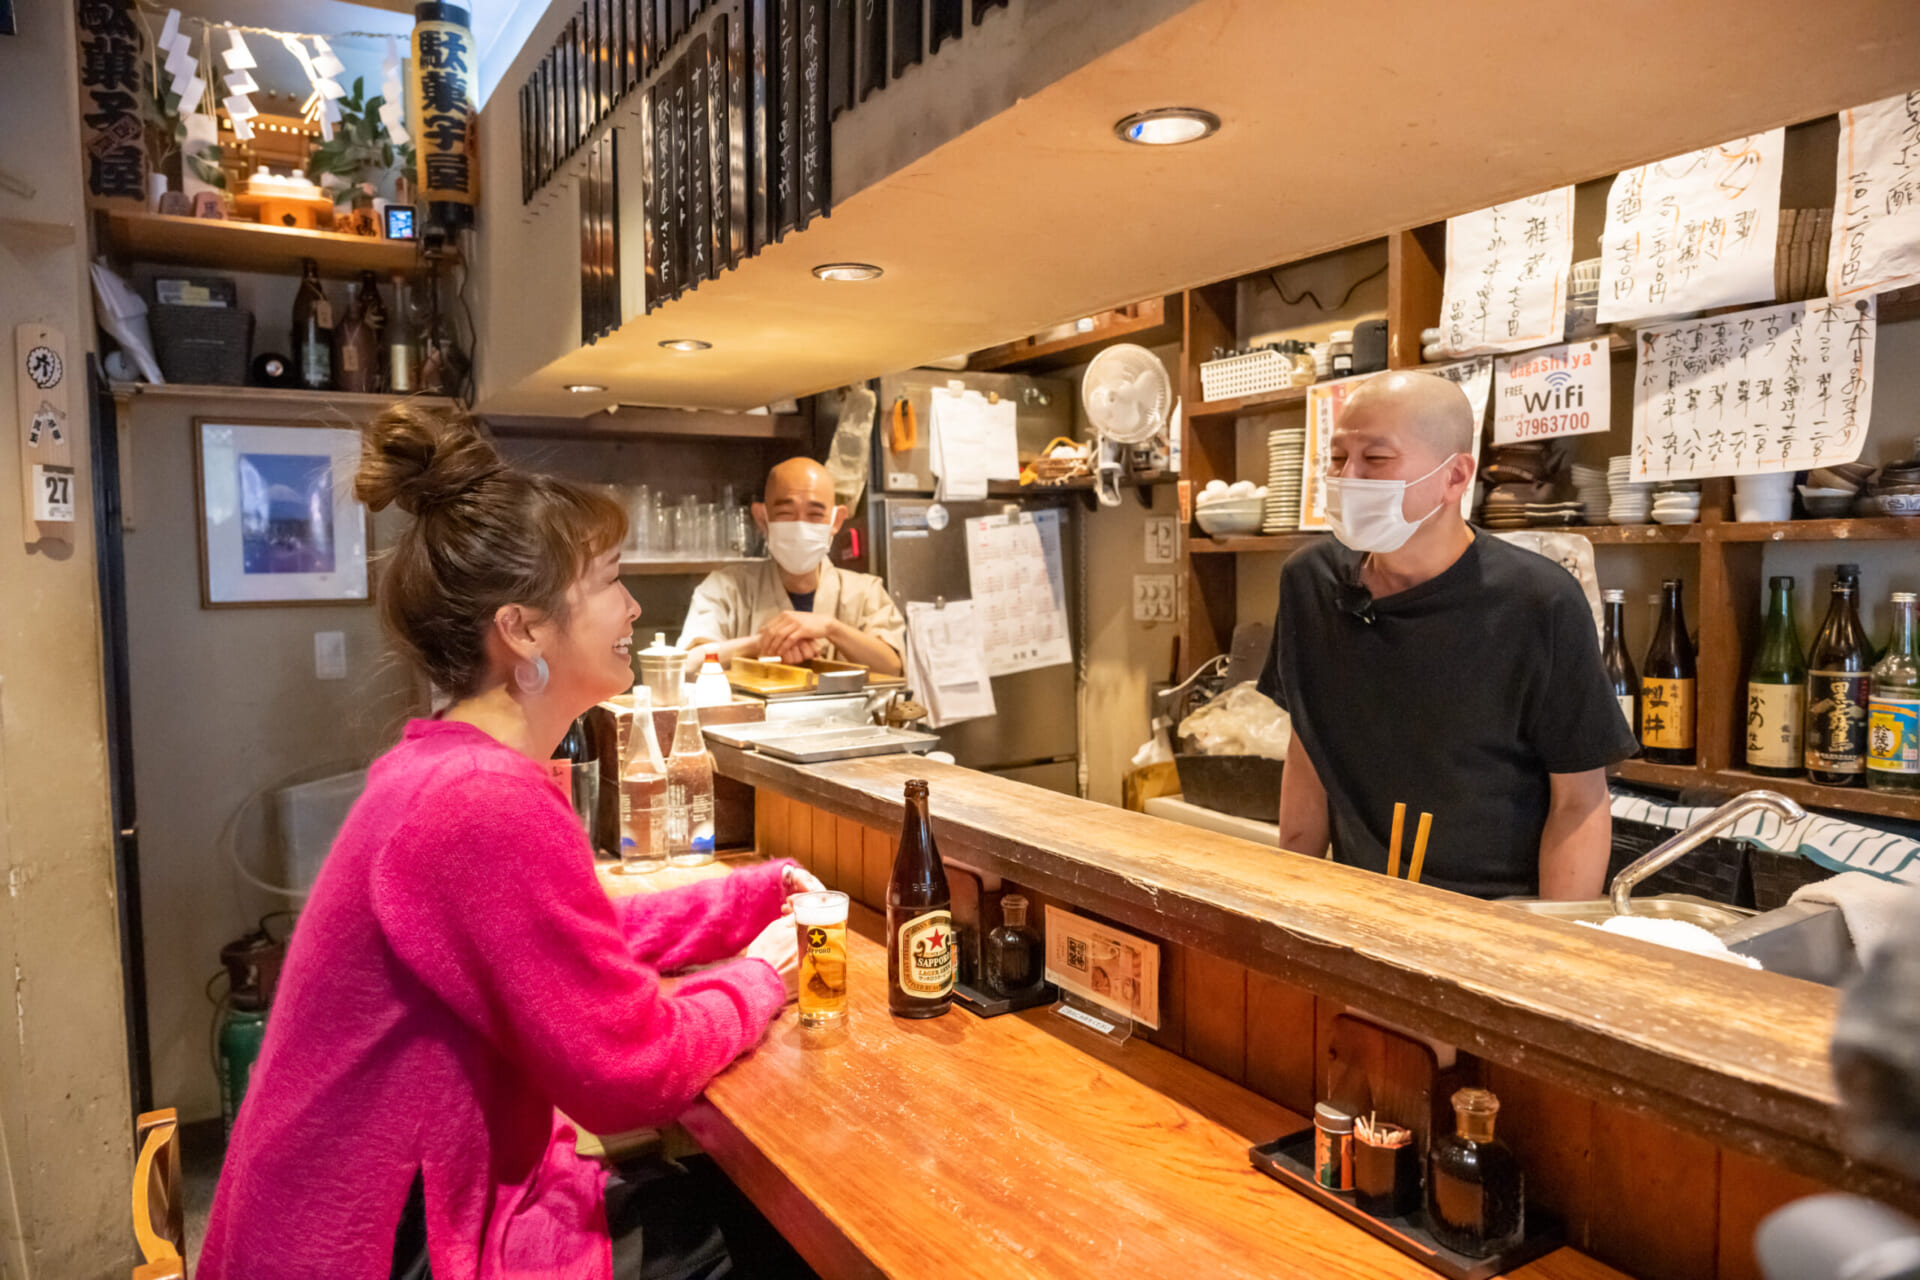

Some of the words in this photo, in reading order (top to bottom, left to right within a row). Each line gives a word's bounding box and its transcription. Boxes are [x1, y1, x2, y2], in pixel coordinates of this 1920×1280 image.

[419, 30, 470, 193] 駄菓子屋
[1509, 352, 1592, 379] dagashiya
[1505, 385, 1523, 397] FREE
[1524, 384, 1583, 413] Wifi
[1516, 412, 1590, 438] 37963700
[46, 477, 68, 504] 27
